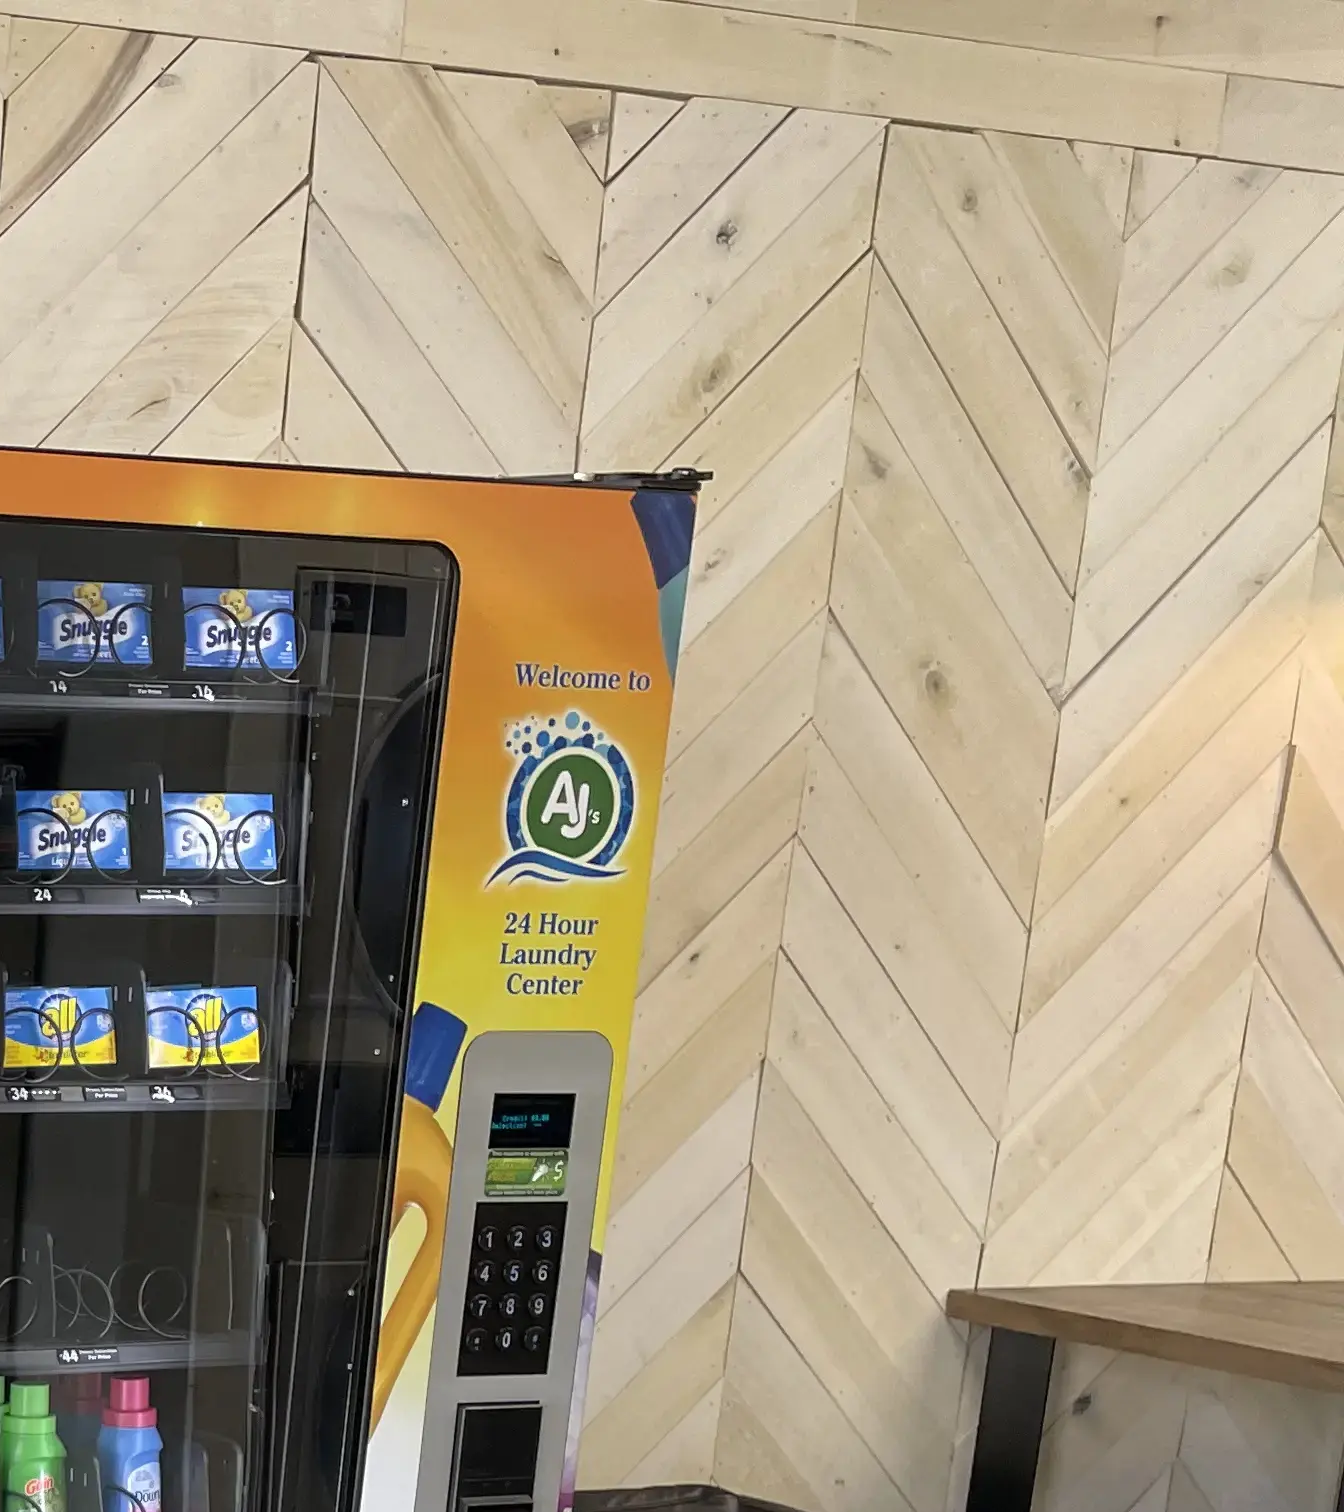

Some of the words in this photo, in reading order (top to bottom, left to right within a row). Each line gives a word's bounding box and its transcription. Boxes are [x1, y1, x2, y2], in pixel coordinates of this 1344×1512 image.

[49, 680, 68, 693] 14
[515, 663, 621, 690] Welcome
[628, 669, 652, 691] to
[541, 770, 600, 839] AJ's
[37, 827, 107, 851] Snuggle
[33, 888, 52, 902] 24
[504, 911, 531, 934] 24
[538, 912, 600, 935] Hour
[499, 942, 597, 971] Laundry
[506, 972, 583, 995] Center
[42, 997, 78, 1037] all
[187, 996, 223, 1037] all
[10, 1087, 29, 1101] 34
[486, 1231, 493, 1248] 1
[513, 1231, 523, 1247] 2
[542, 1230, 552, 1248] 3
[480, 1265, 490, 1282] 4
[509, 1265, 519, 1282] 5
[537, 1264, 548, 1281] 6
[478, 1300, 487, 1317] 7
[505, 1298, 515, 1315] 8
[534, 1298, 544, 1315] 9
[502, 1332, 511, 1348] 0
[62, 1349, 79, 1363] 44
